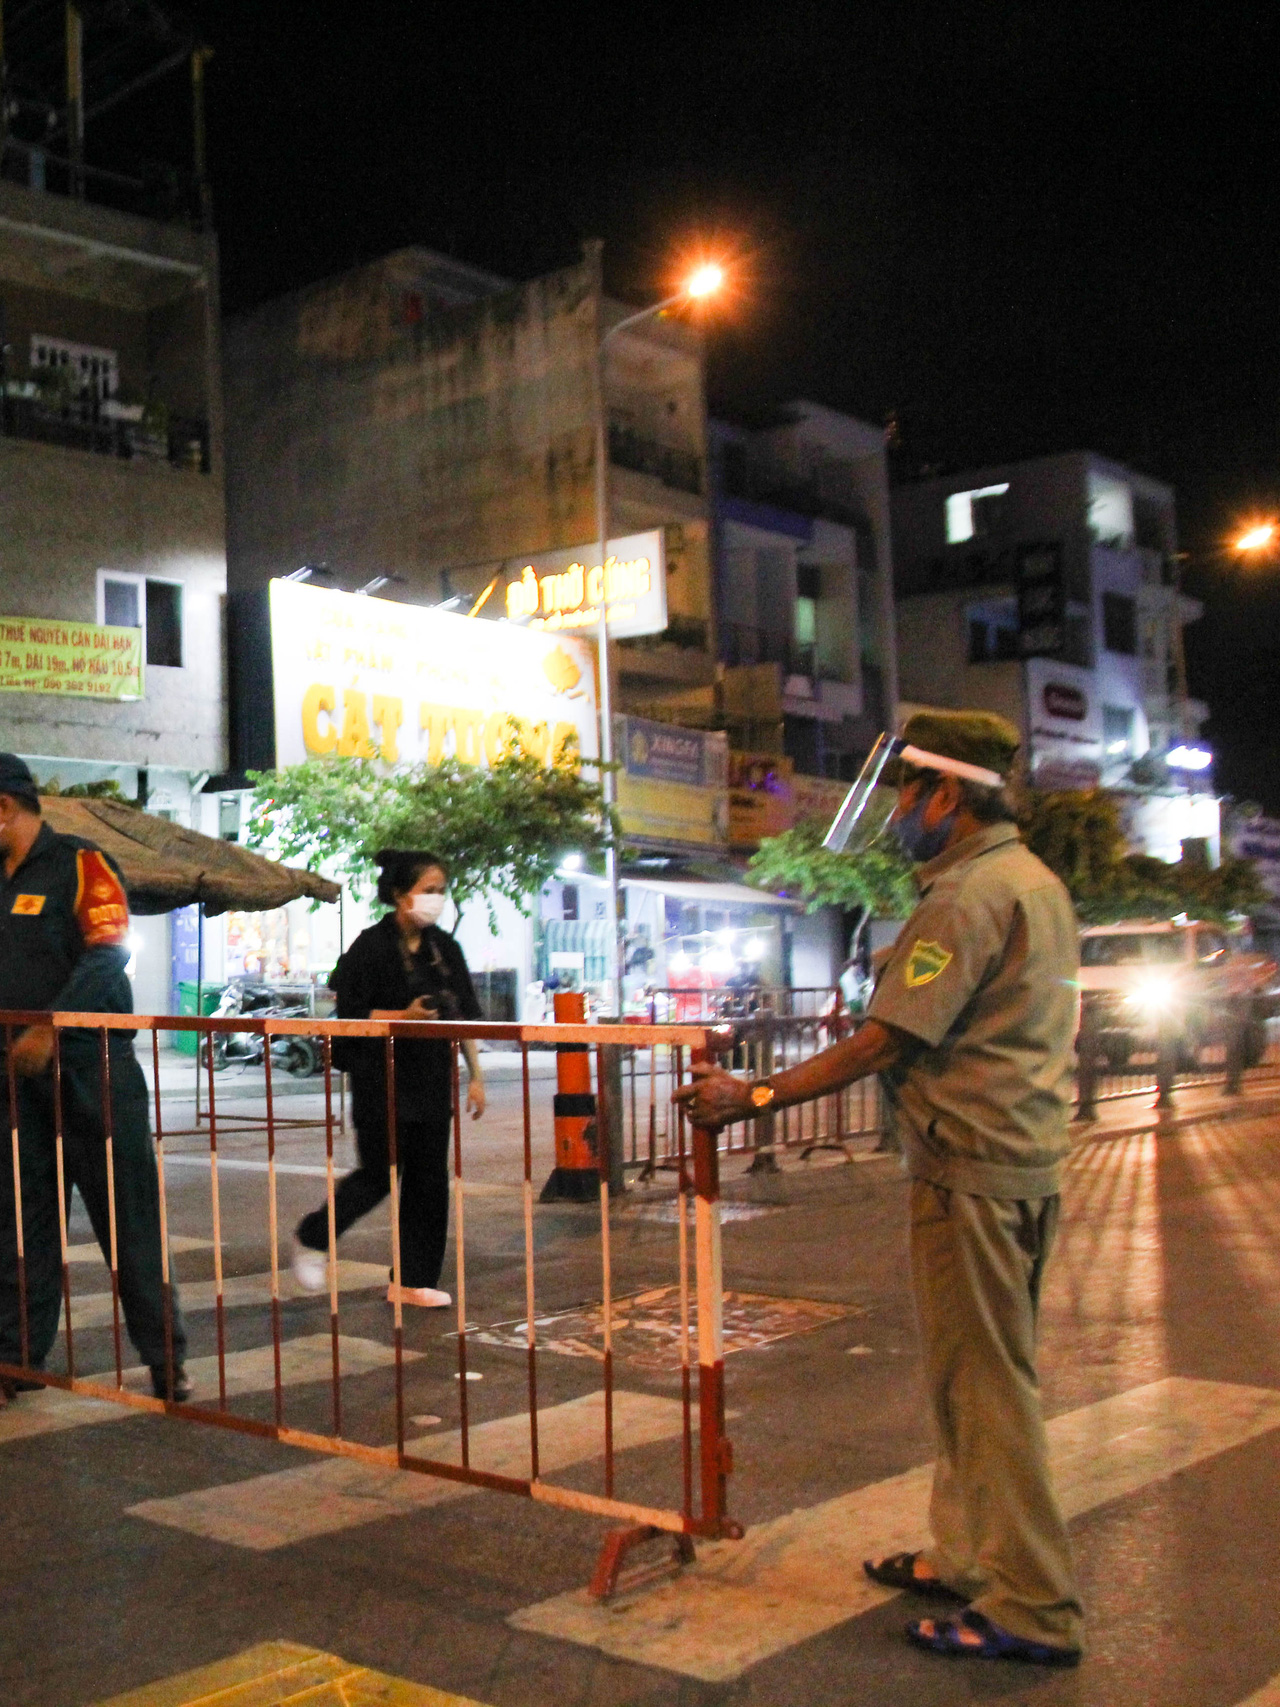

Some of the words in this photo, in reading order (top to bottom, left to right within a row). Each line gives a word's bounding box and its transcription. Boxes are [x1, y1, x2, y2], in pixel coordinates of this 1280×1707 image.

[0, 619, 25, 643] THUÊ
[29, 624, 69, 647] NGUYÊN
[301, 674, 404, 763] CÁT
